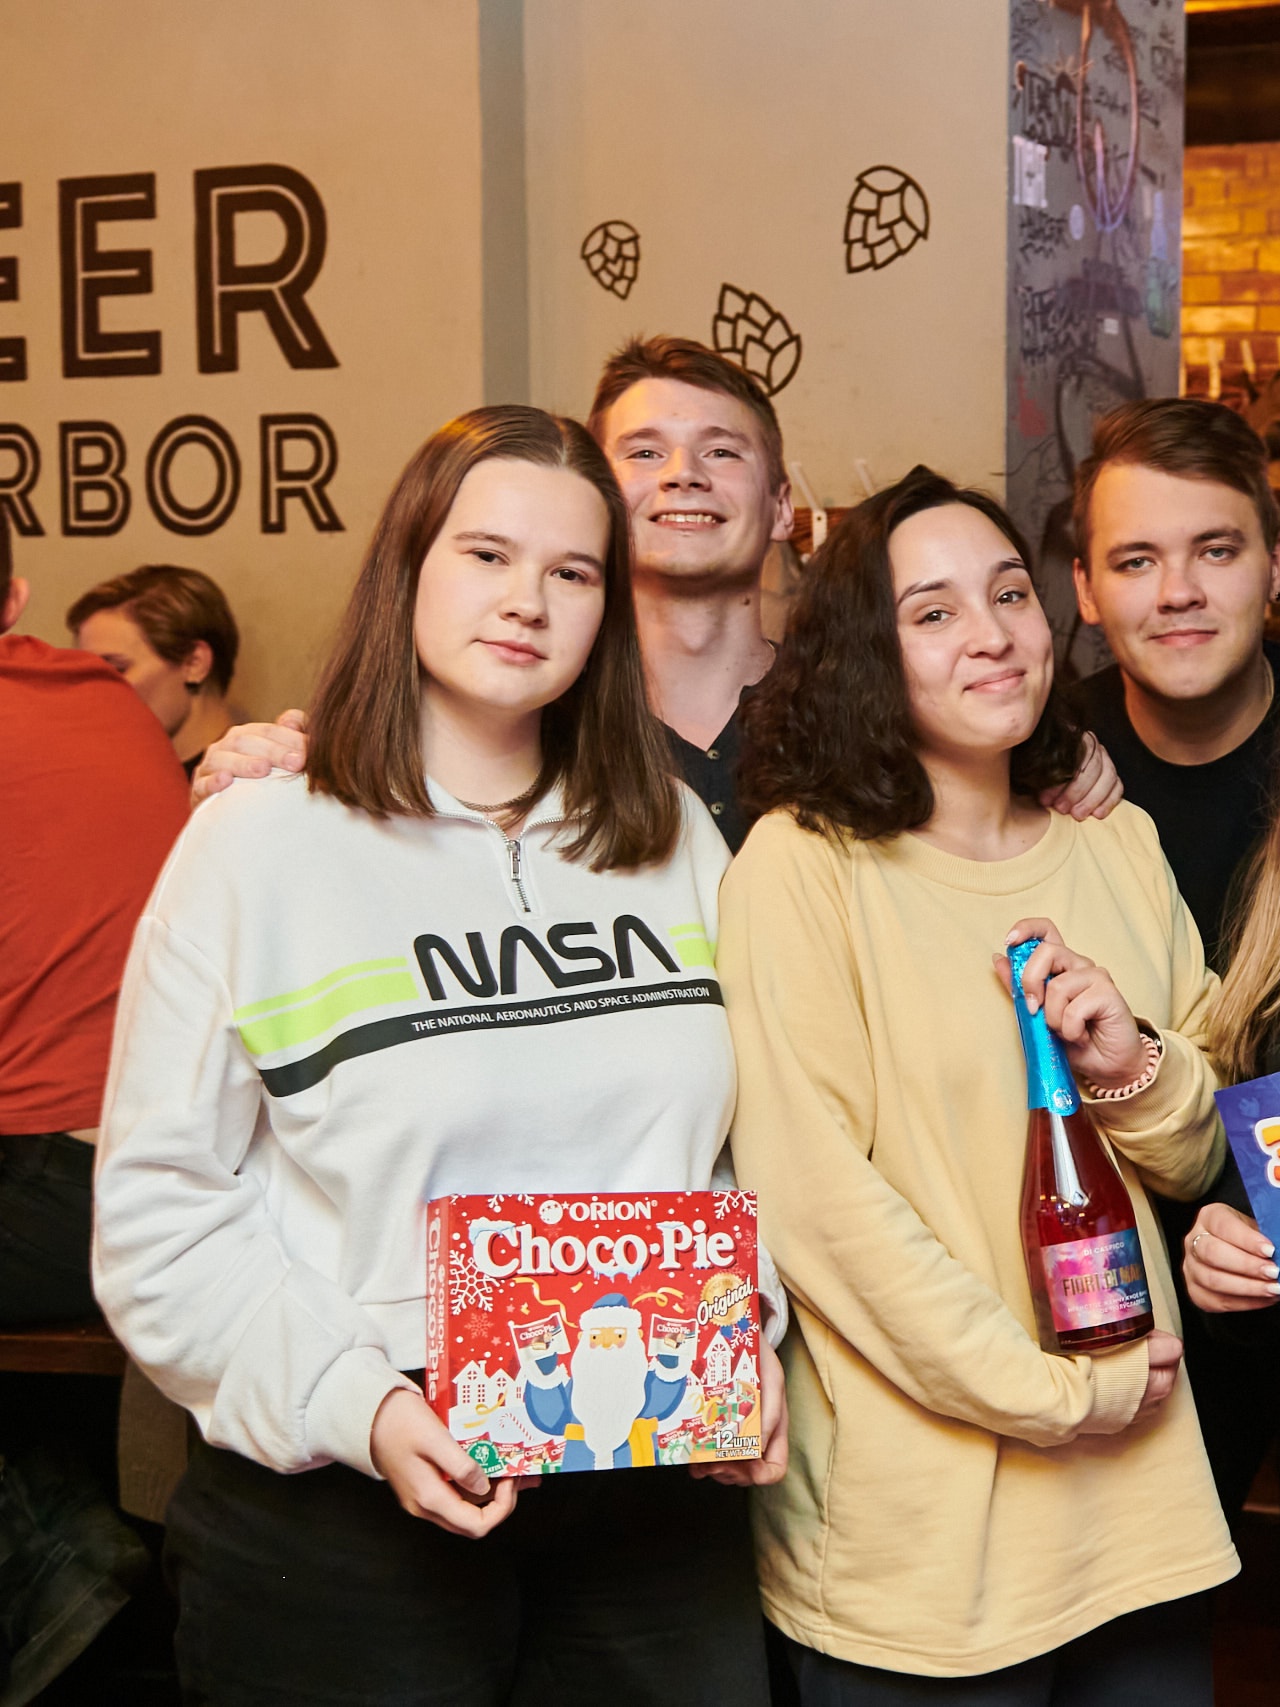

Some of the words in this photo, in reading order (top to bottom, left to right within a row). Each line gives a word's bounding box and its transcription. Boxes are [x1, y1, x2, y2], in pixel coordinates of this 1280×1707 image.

[0, 163, 341, 381] ER
[413, 914, 681, 1001] NASA
[412, 1019, 437, 1032] THE
[438, 1012, 495, 1028] NATIONAL
[496, 1002, 572, 1022] AERONAUTICS
[574, 999, 598, 1012] AND
[599, 994, 631, 1009] SPACE
[632, 987, 710, 1003] ADMINISTRATION
[1094, 1241, 1125, 1254] CASPICO
[697, 1275, 754, 1326] Original
[1062, 1273, 1100, 1297] FIORI
